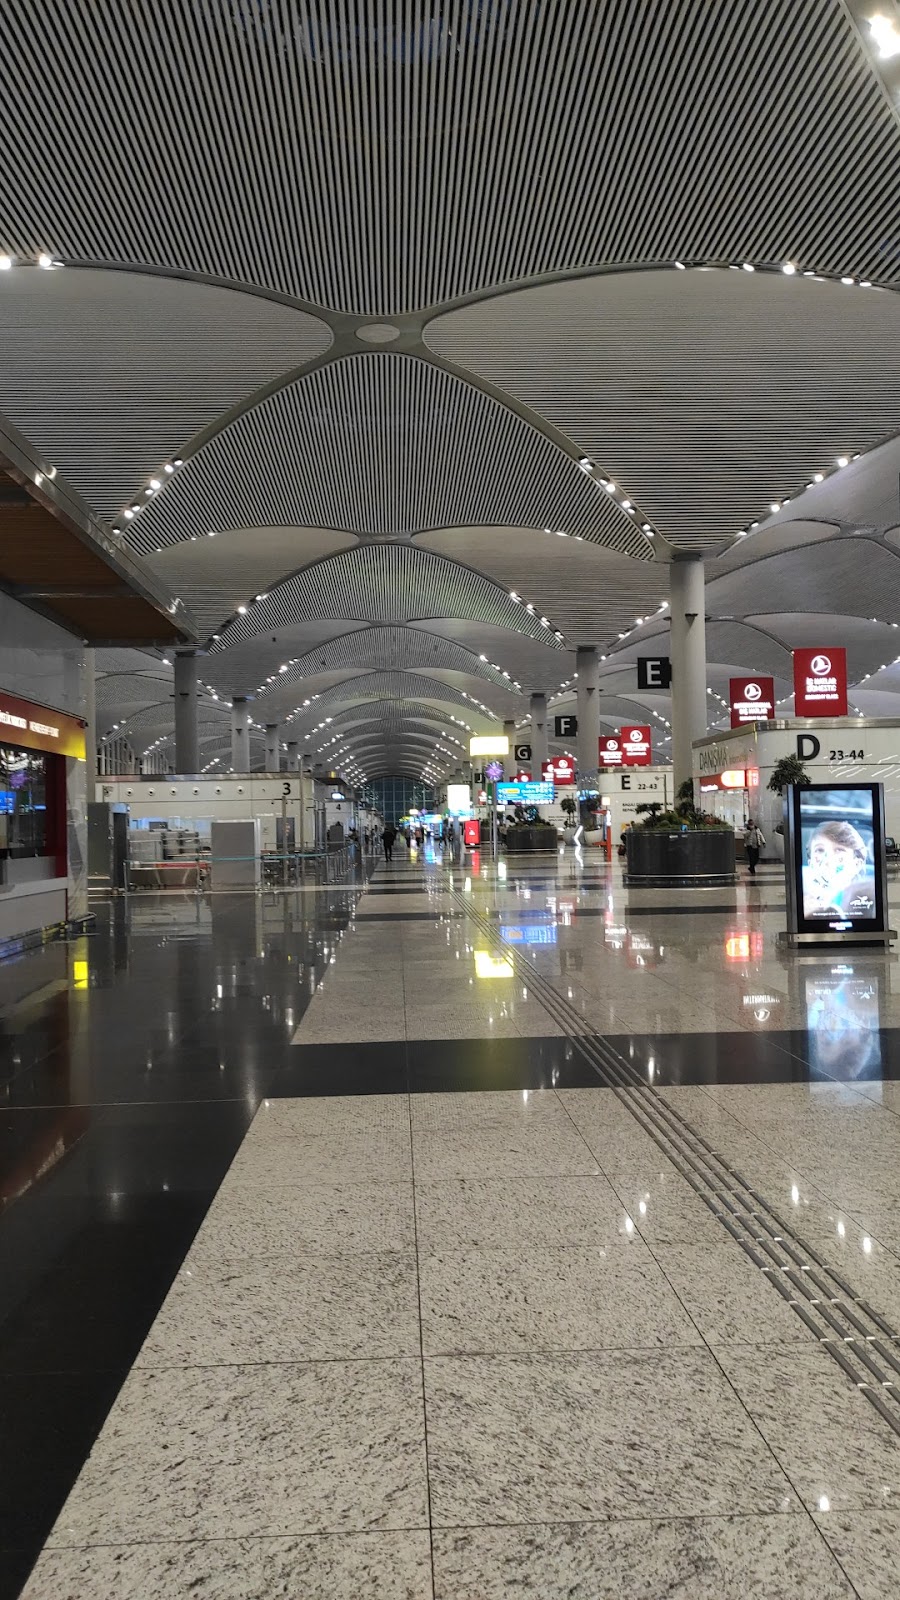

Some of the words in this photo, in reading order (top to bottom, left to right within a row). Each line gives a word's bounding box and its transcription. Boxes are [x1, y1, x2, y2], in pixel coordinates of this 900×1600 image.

[646, 661, 661, 685] E
[560, 718, 570, 735] F
[517, 746, 528, 759] G
[797, 734, 821, 761] D
[829, 750, 865, 761] 23-44
[282, 782, 291, 796] 3
[621, 775, 631, 790] E
